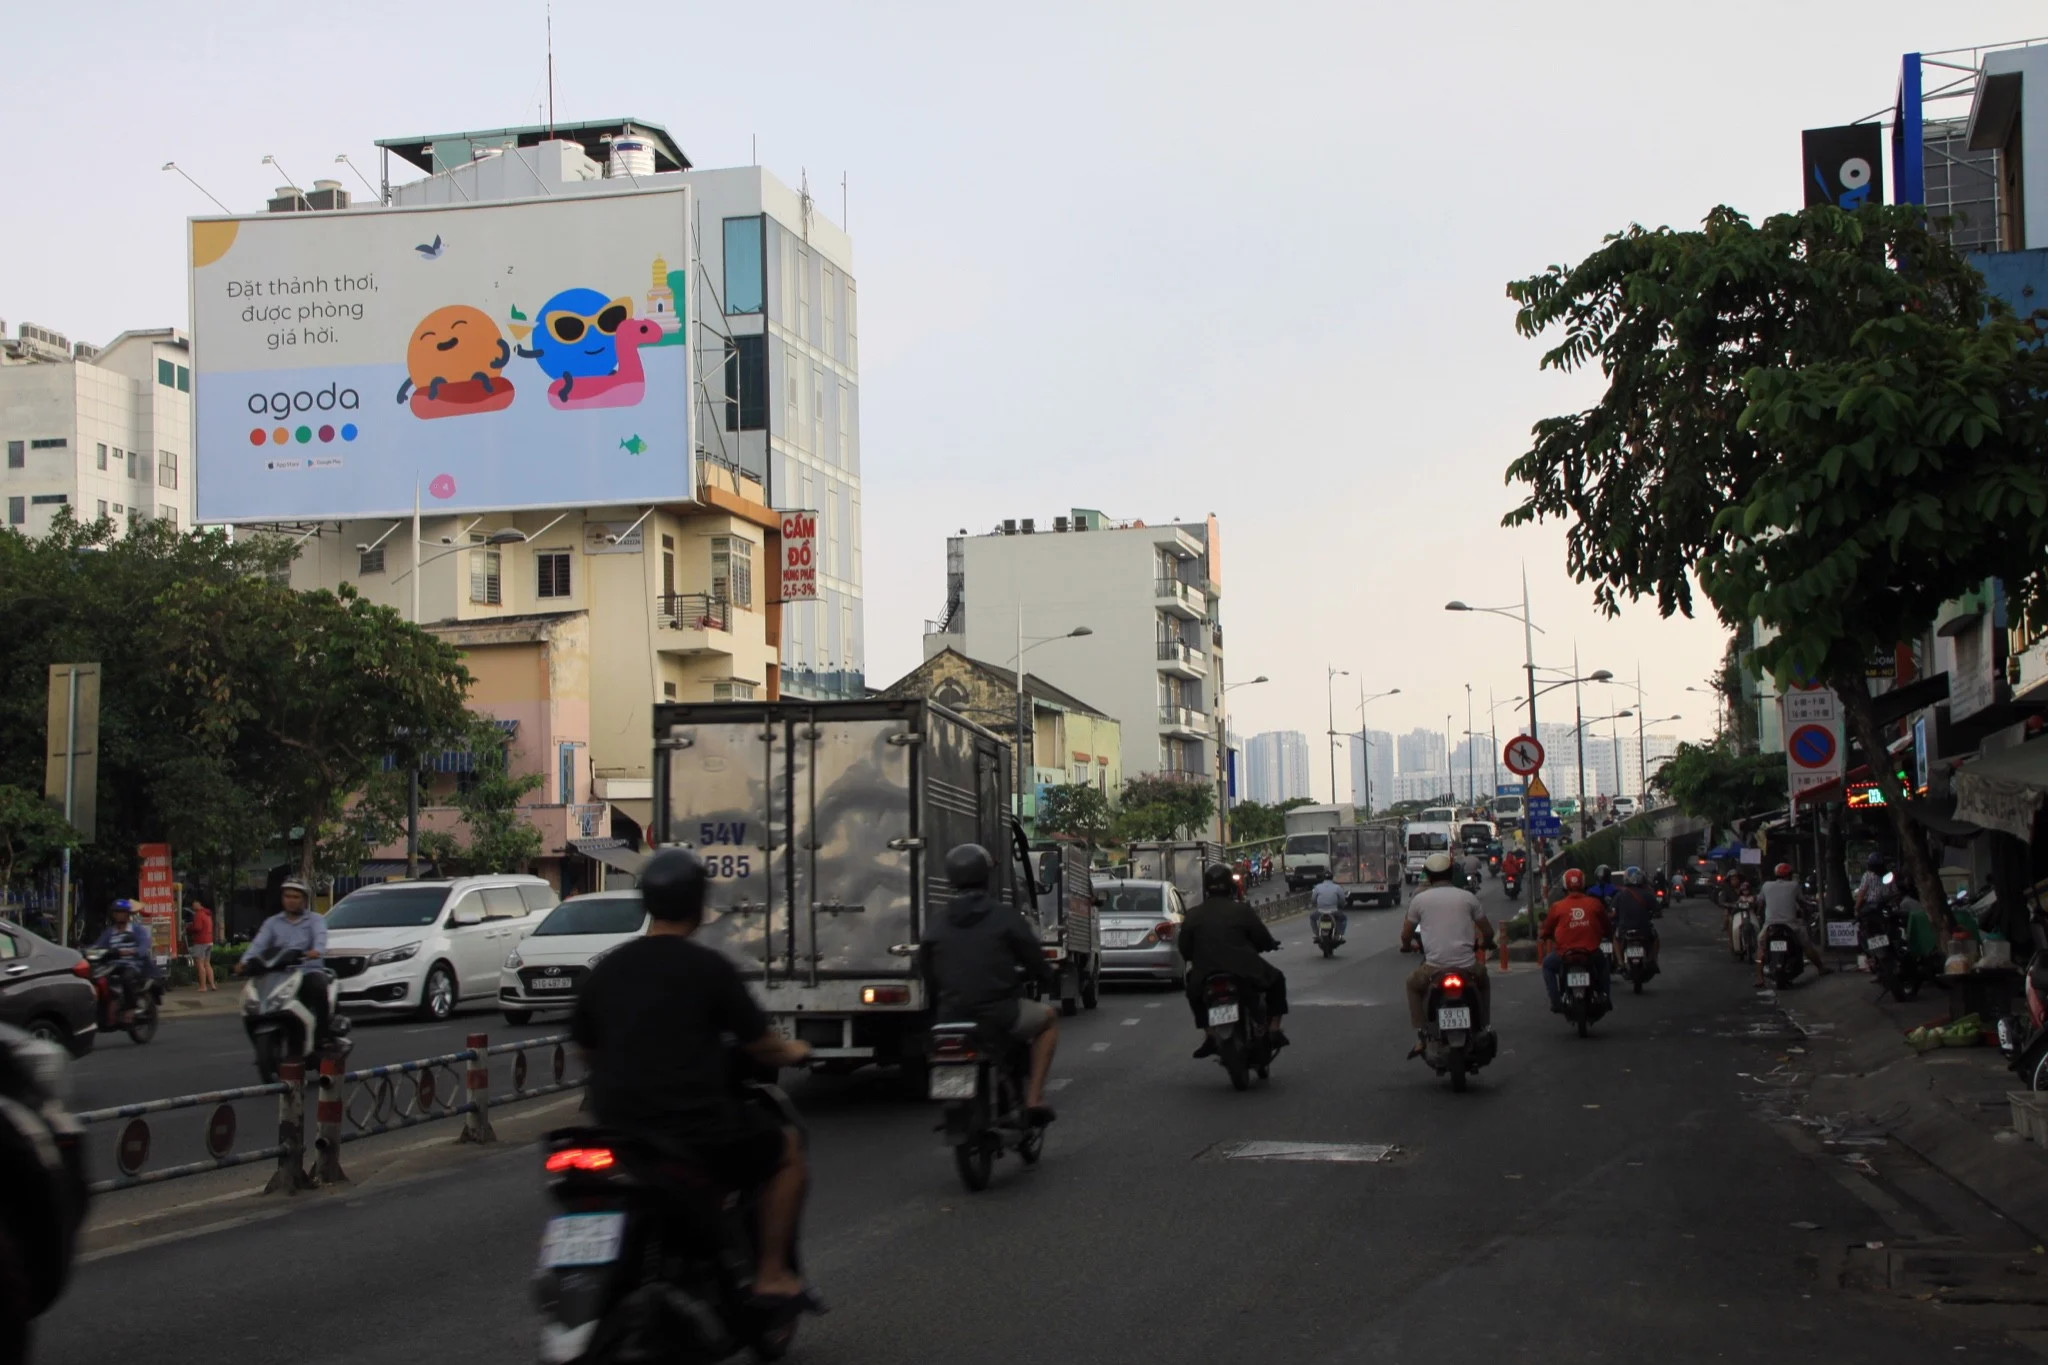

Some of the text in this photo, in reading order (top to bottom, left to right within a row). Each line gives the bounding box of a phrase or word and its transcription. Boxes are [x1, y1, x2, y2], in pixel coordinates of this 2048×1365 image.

[226, 272, 378, 300] Đặt thảnh thơi,
[241, 300, 364, 324] được phòng
[266, 326, 339, 350] giá hời.
[247, 381, 359, 420] agoda
[700, 822, 747, 846] 54V
